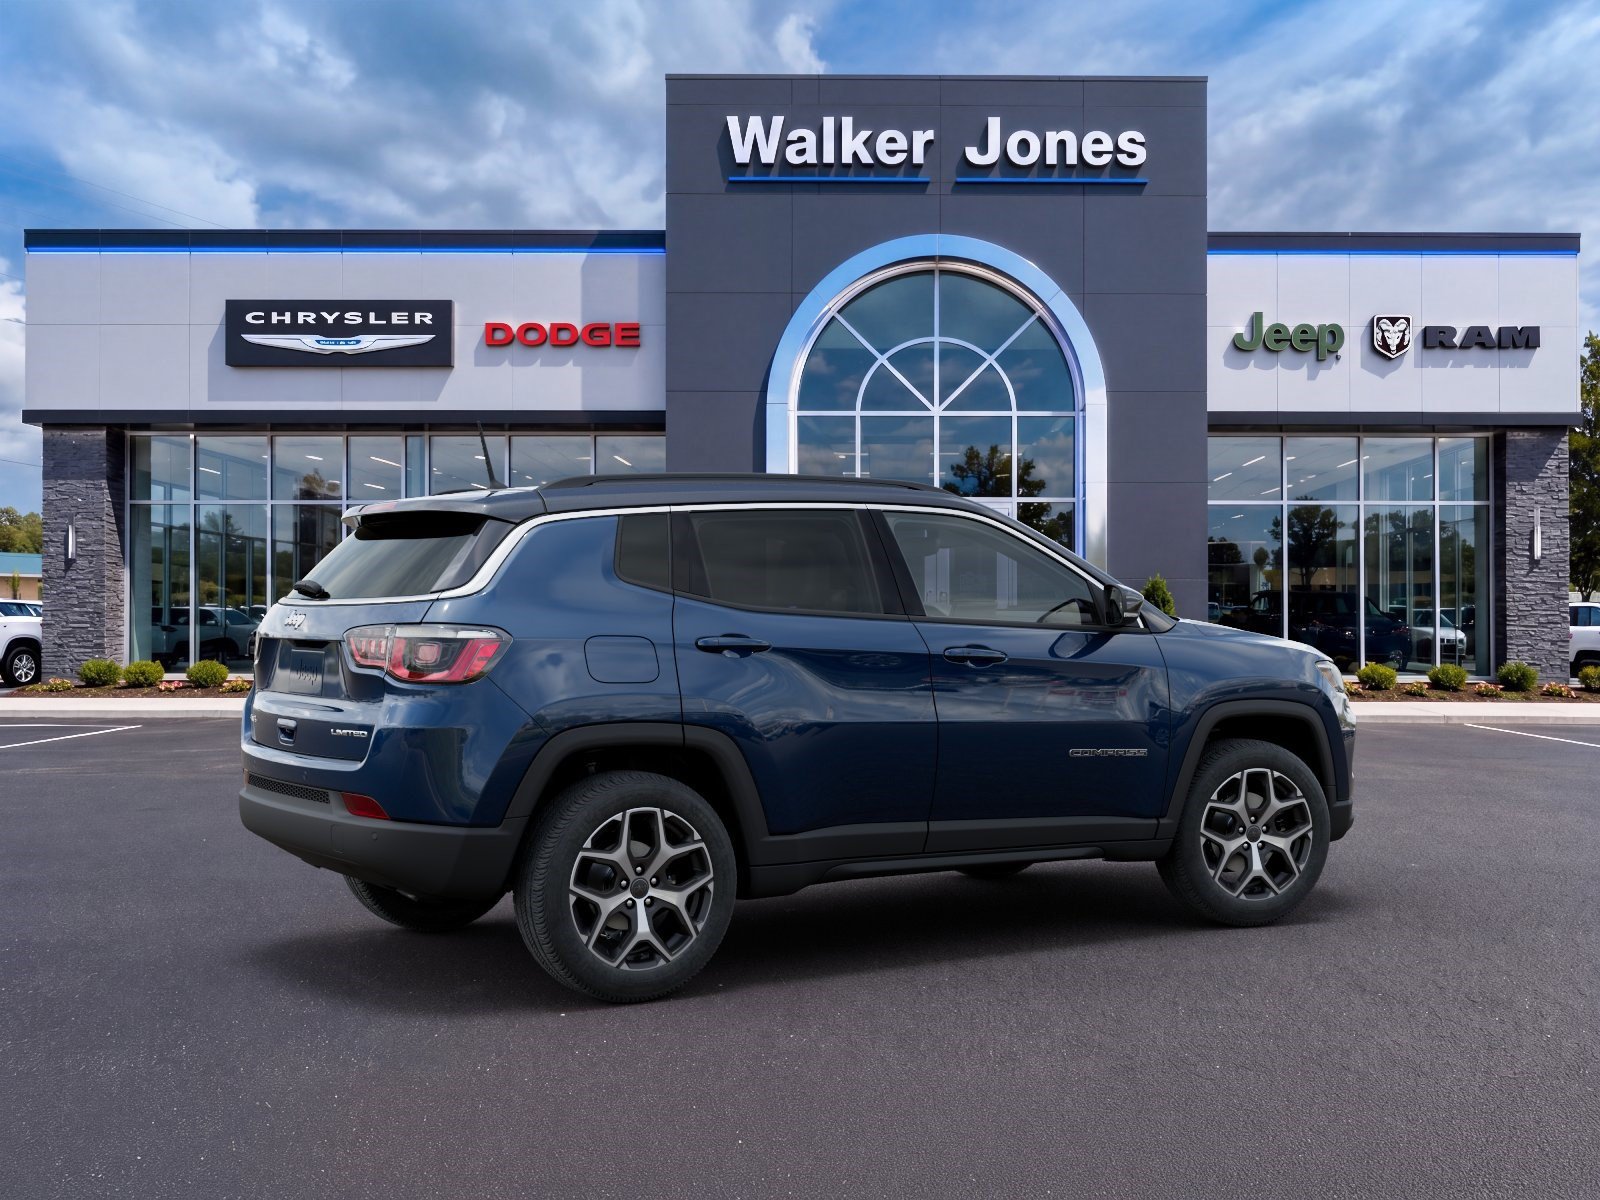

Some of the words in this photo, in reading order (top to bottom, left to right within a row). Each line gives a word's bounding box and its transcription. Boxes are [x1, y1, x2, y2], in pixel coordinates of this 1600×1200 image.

[726, 115, 934, 164] Walker
[965, 116, 1147, 165] Jones
[245, 311, 433, 325] CHRYSLER
[484, 322, 641, 347] DODGE
[1234, 311, 1345, 361] Jeep
[1423, 326, 1541, 349] RAM
[330, 728, 368, 737] LIMITED
[1069, 748, 1148, 757] COMPASS
